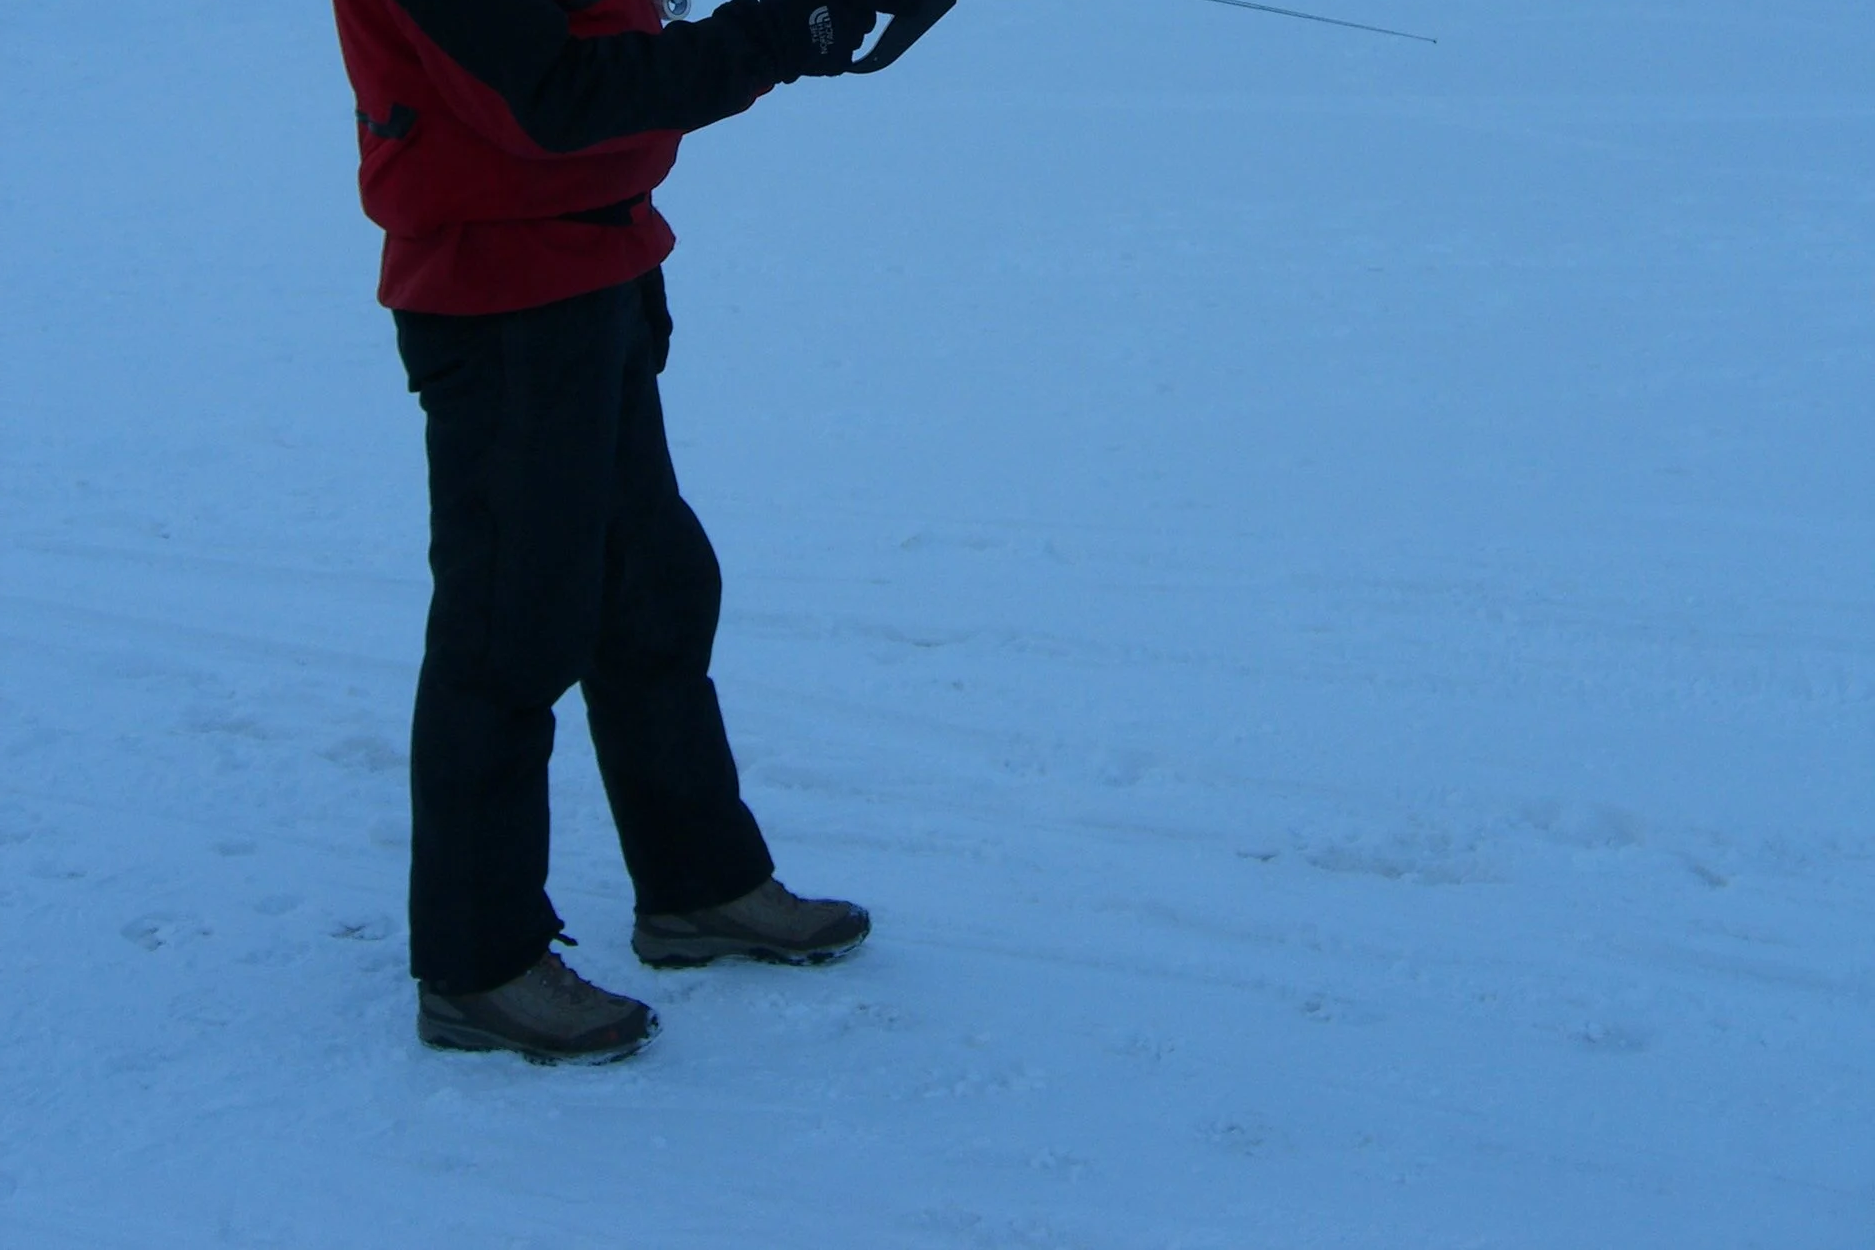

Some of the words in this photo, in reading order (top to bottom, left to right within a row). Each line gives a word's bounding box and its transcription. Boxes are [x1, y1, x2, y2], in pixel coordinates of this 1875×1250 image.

[810, 25, 819, 44] THE
[818, 23, 828, 55] NORTH
[826, 20, 834, 45] FACE
